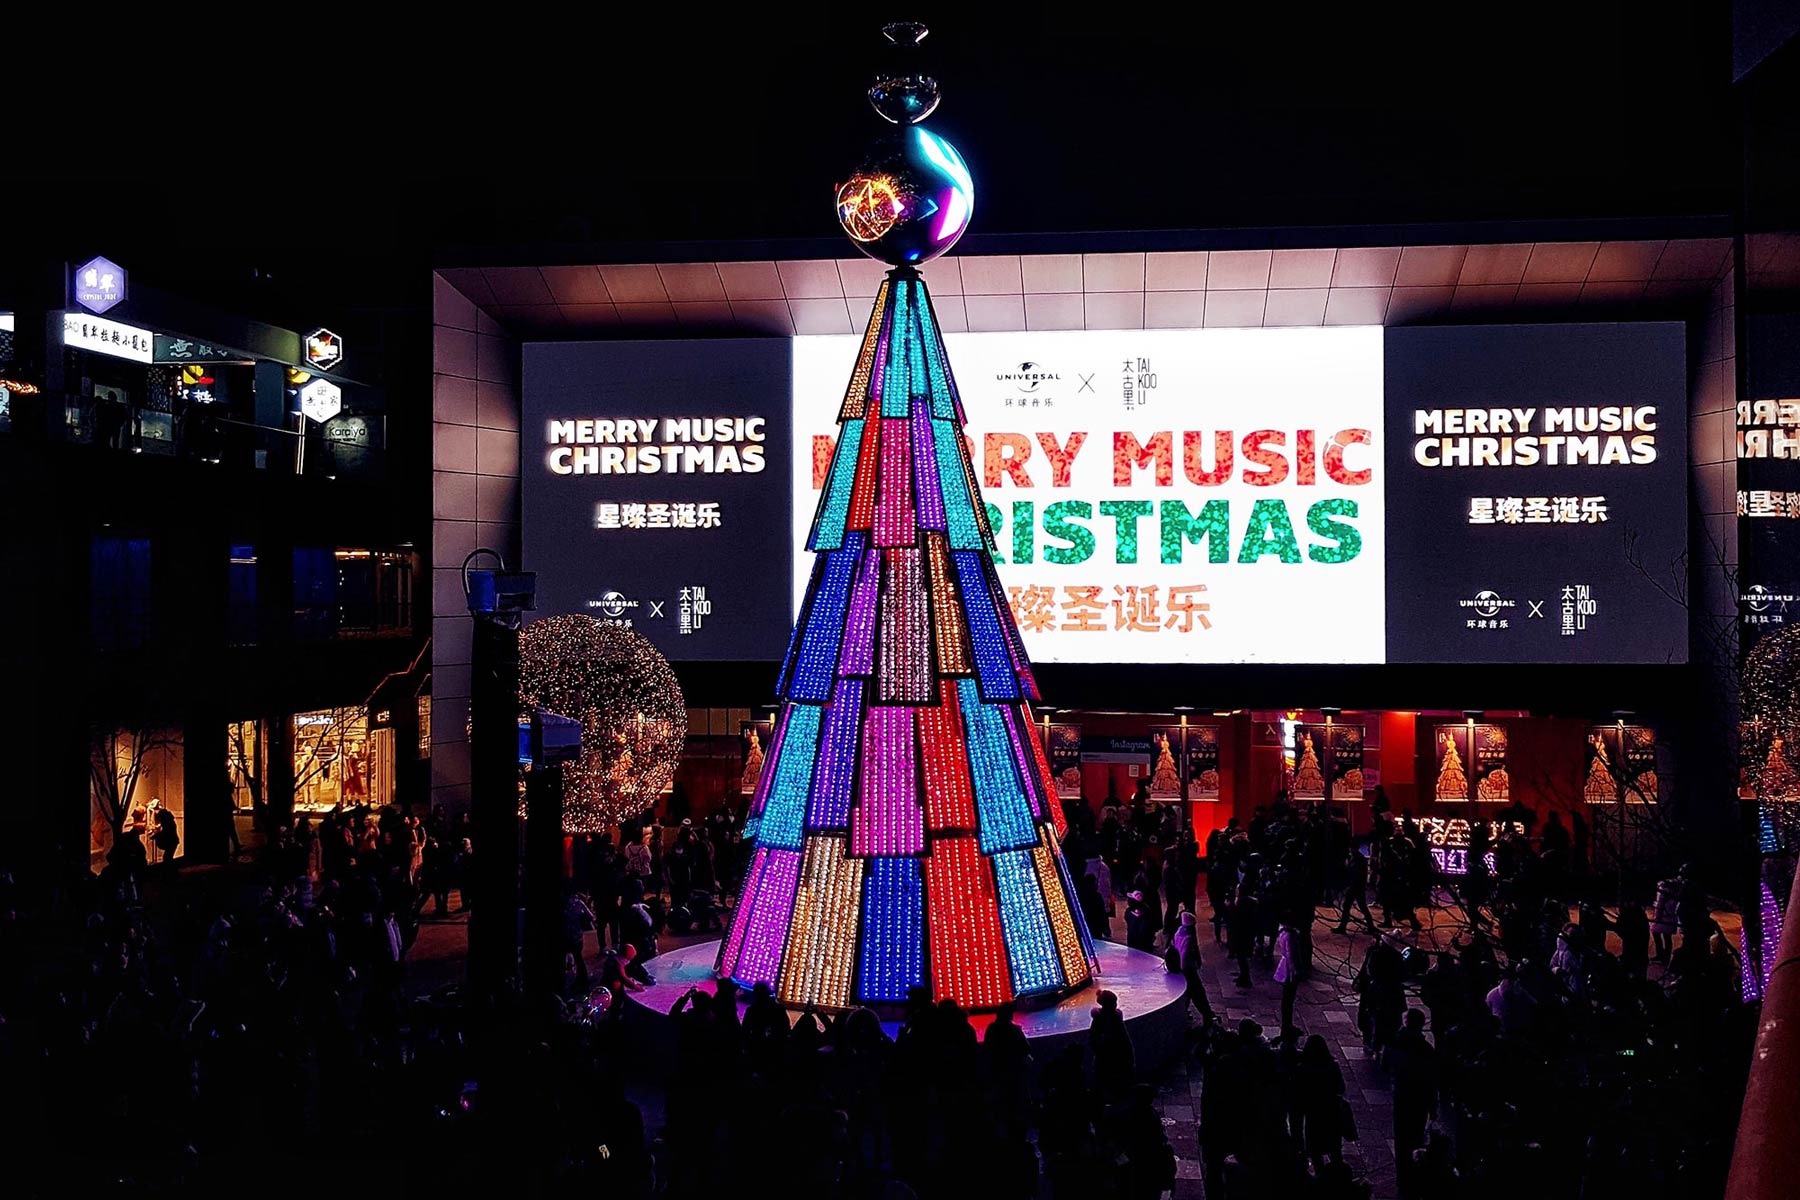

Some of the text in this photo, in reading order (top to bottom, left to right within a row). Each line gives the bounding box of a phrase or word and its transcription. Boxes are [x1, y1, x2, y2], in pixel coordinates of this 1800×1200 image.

[1136, 357, 1150, 373] TAI
[996, 373, 1061, 381] UNIVERSAL
[1137, 373, 1158, 389] KOO
[1415, 405, 1657, 434] MERRY MUSIC
[328, 425, 366, 438] Karaiya
[548, 417, 766, 444] MERRY MUSIC
[1113, 428, 1372, 488] MUSIC
[1414, 434, 1657, 466] CHRISTMAS
[548, 445, 766, 475] CHRISTMAS
[597, 503, 721, 529] 星璨圣诞乐
[1468, 497, 1608, 524] 星璨圣诞乐
[984, 499, 1363, 565] ISTMAS
[693, 586, 706, 600] TAI
[1575, 585, 1590, 600] TAI
[589, 600, 639, 608] UNIVERSAL
[694, 601, 711, 614] KOO
[1008, 584, 1211, 634] 璨圣诞乐
[1459, 600, 1515, 608] UNIVERSAL
[1577, 600, 1597, 615] KOO
[1466, 619, 1509, 629] 环球音乐
